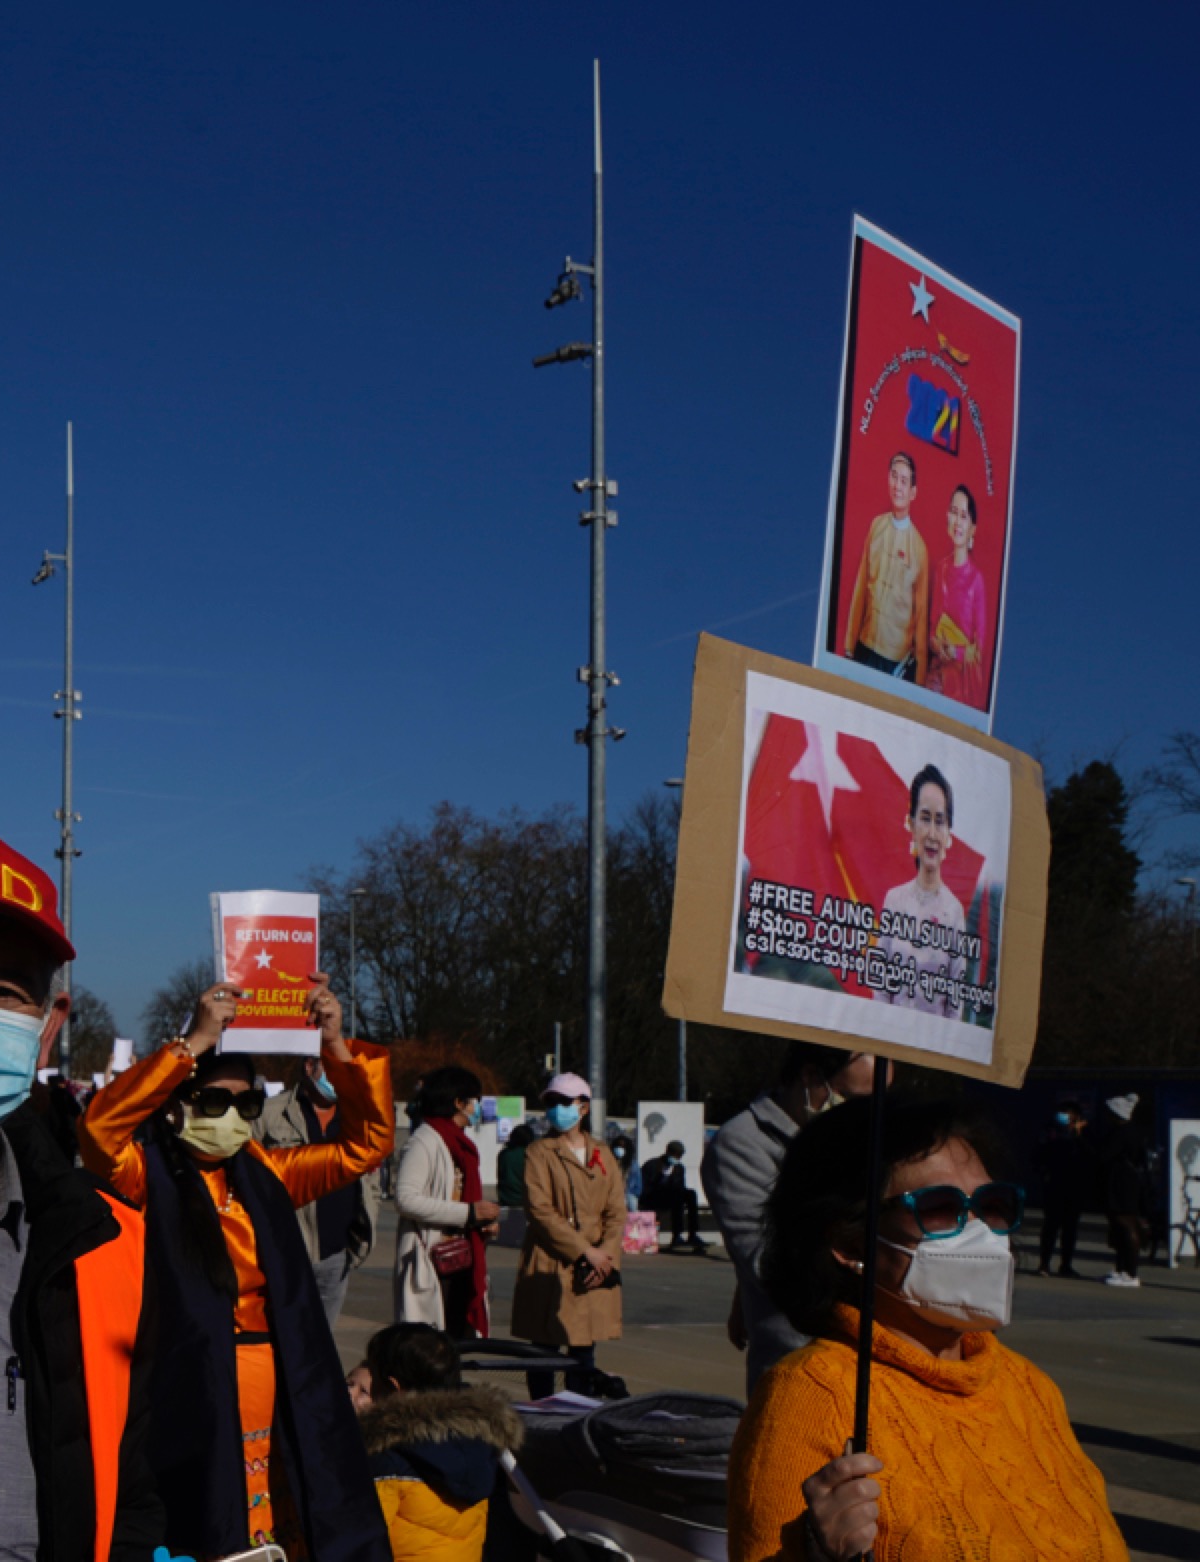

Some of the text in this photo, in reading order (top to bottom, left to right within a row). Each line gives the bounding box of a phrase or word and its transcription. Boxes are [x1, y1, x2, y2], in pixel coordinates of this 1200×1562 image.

[235, 929, 314, 943] RETURN OUR
[748, 907, 868, 951] #Stop_COUP
[257, 989, 308, 1003] ELECTE
